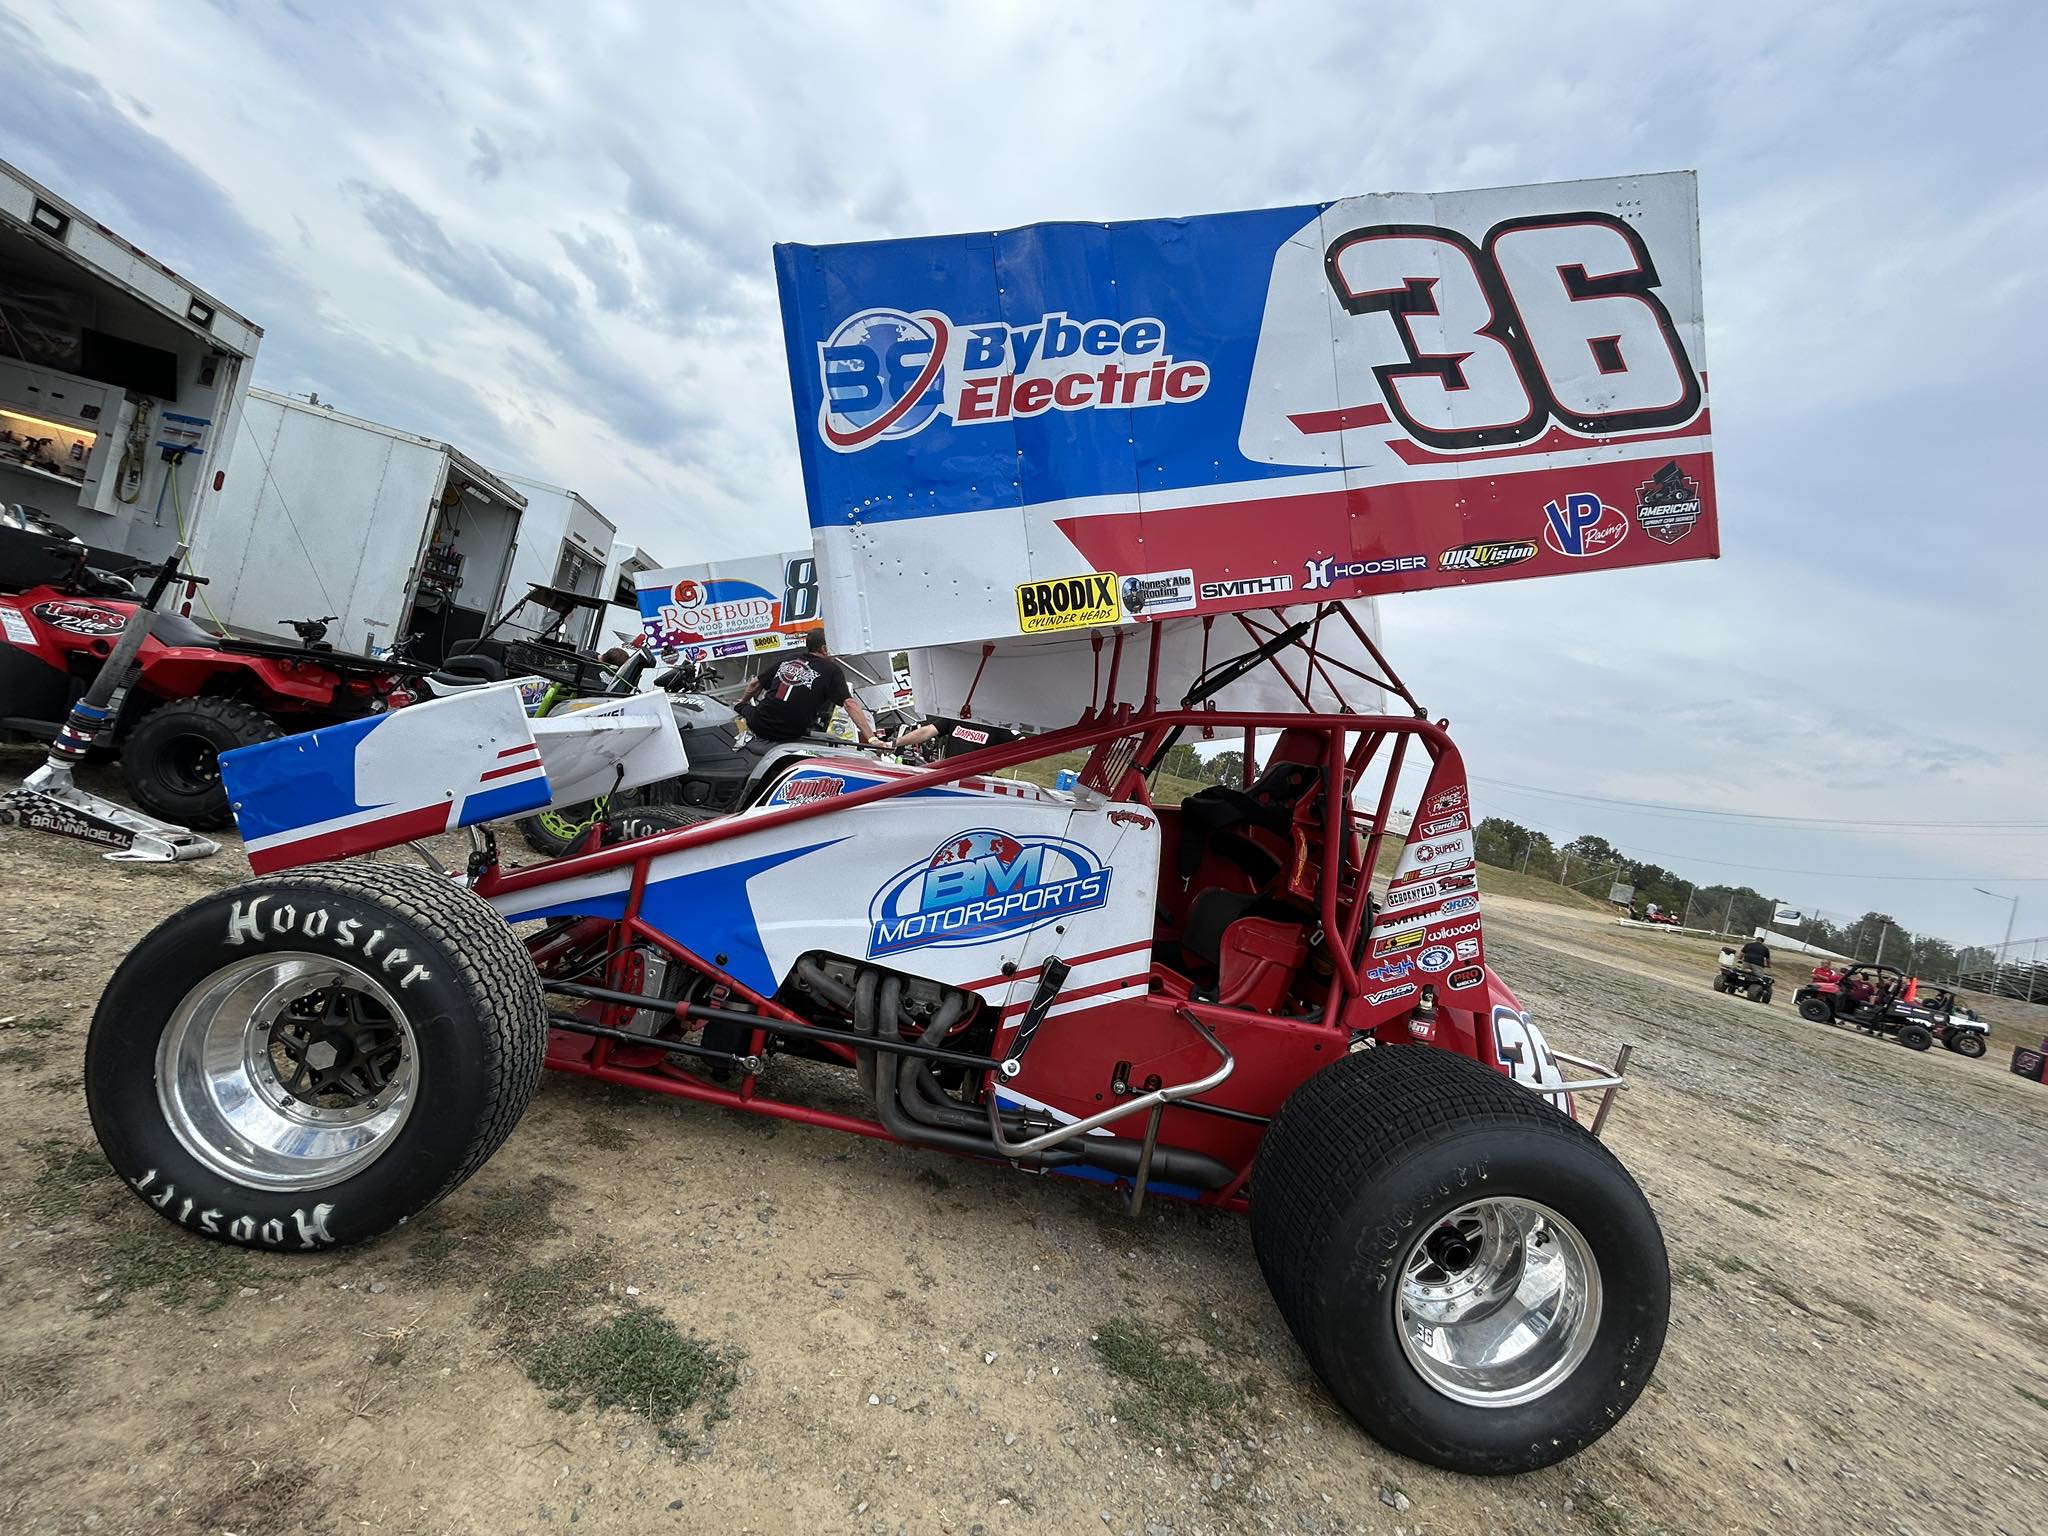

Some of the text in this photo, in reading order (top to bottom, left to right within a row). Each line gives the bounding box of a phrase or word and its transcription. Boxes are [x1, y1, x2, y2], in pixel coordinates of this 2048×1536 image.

[1322, 210, 1701, 451] 36
[962, 317, 1163, 375] Bybee
[957, 359, 1206, 421] Electric
[1639, 502, 1697, 517] AMERICAN
[1543, 492, 1602, 556] VP
[1584, 522, 1622, 548] Racing
[1334, 556, 1426, 577] HOOSIER
[1139, 576, 1191, 589] Honest Abe
[1143, 587, 1178, 598] Roofing
[1021, 576, 1114, 617] BRODIX
[664, 600, 769, 629] ROSEBUD
[698, 615, 770, 632] WOOD PRODUCTS
[1028, 613, 1076, 629] CYLINDER
[1079, 609, 1113, 621] HEADS
[955, 727, 986, 742] SIMPSON
[1435, 841, 1461, 855] SUPPLY
[1389, 885, 1434, 905] SCHOENFELD
[878, 876, 1099, 945] MOTORSPORTS
[1427, 919, 1480, 941] wilwood
[224, 894, 433, 989] Hoosier
[1453, 969, 1479, 982] PRO
